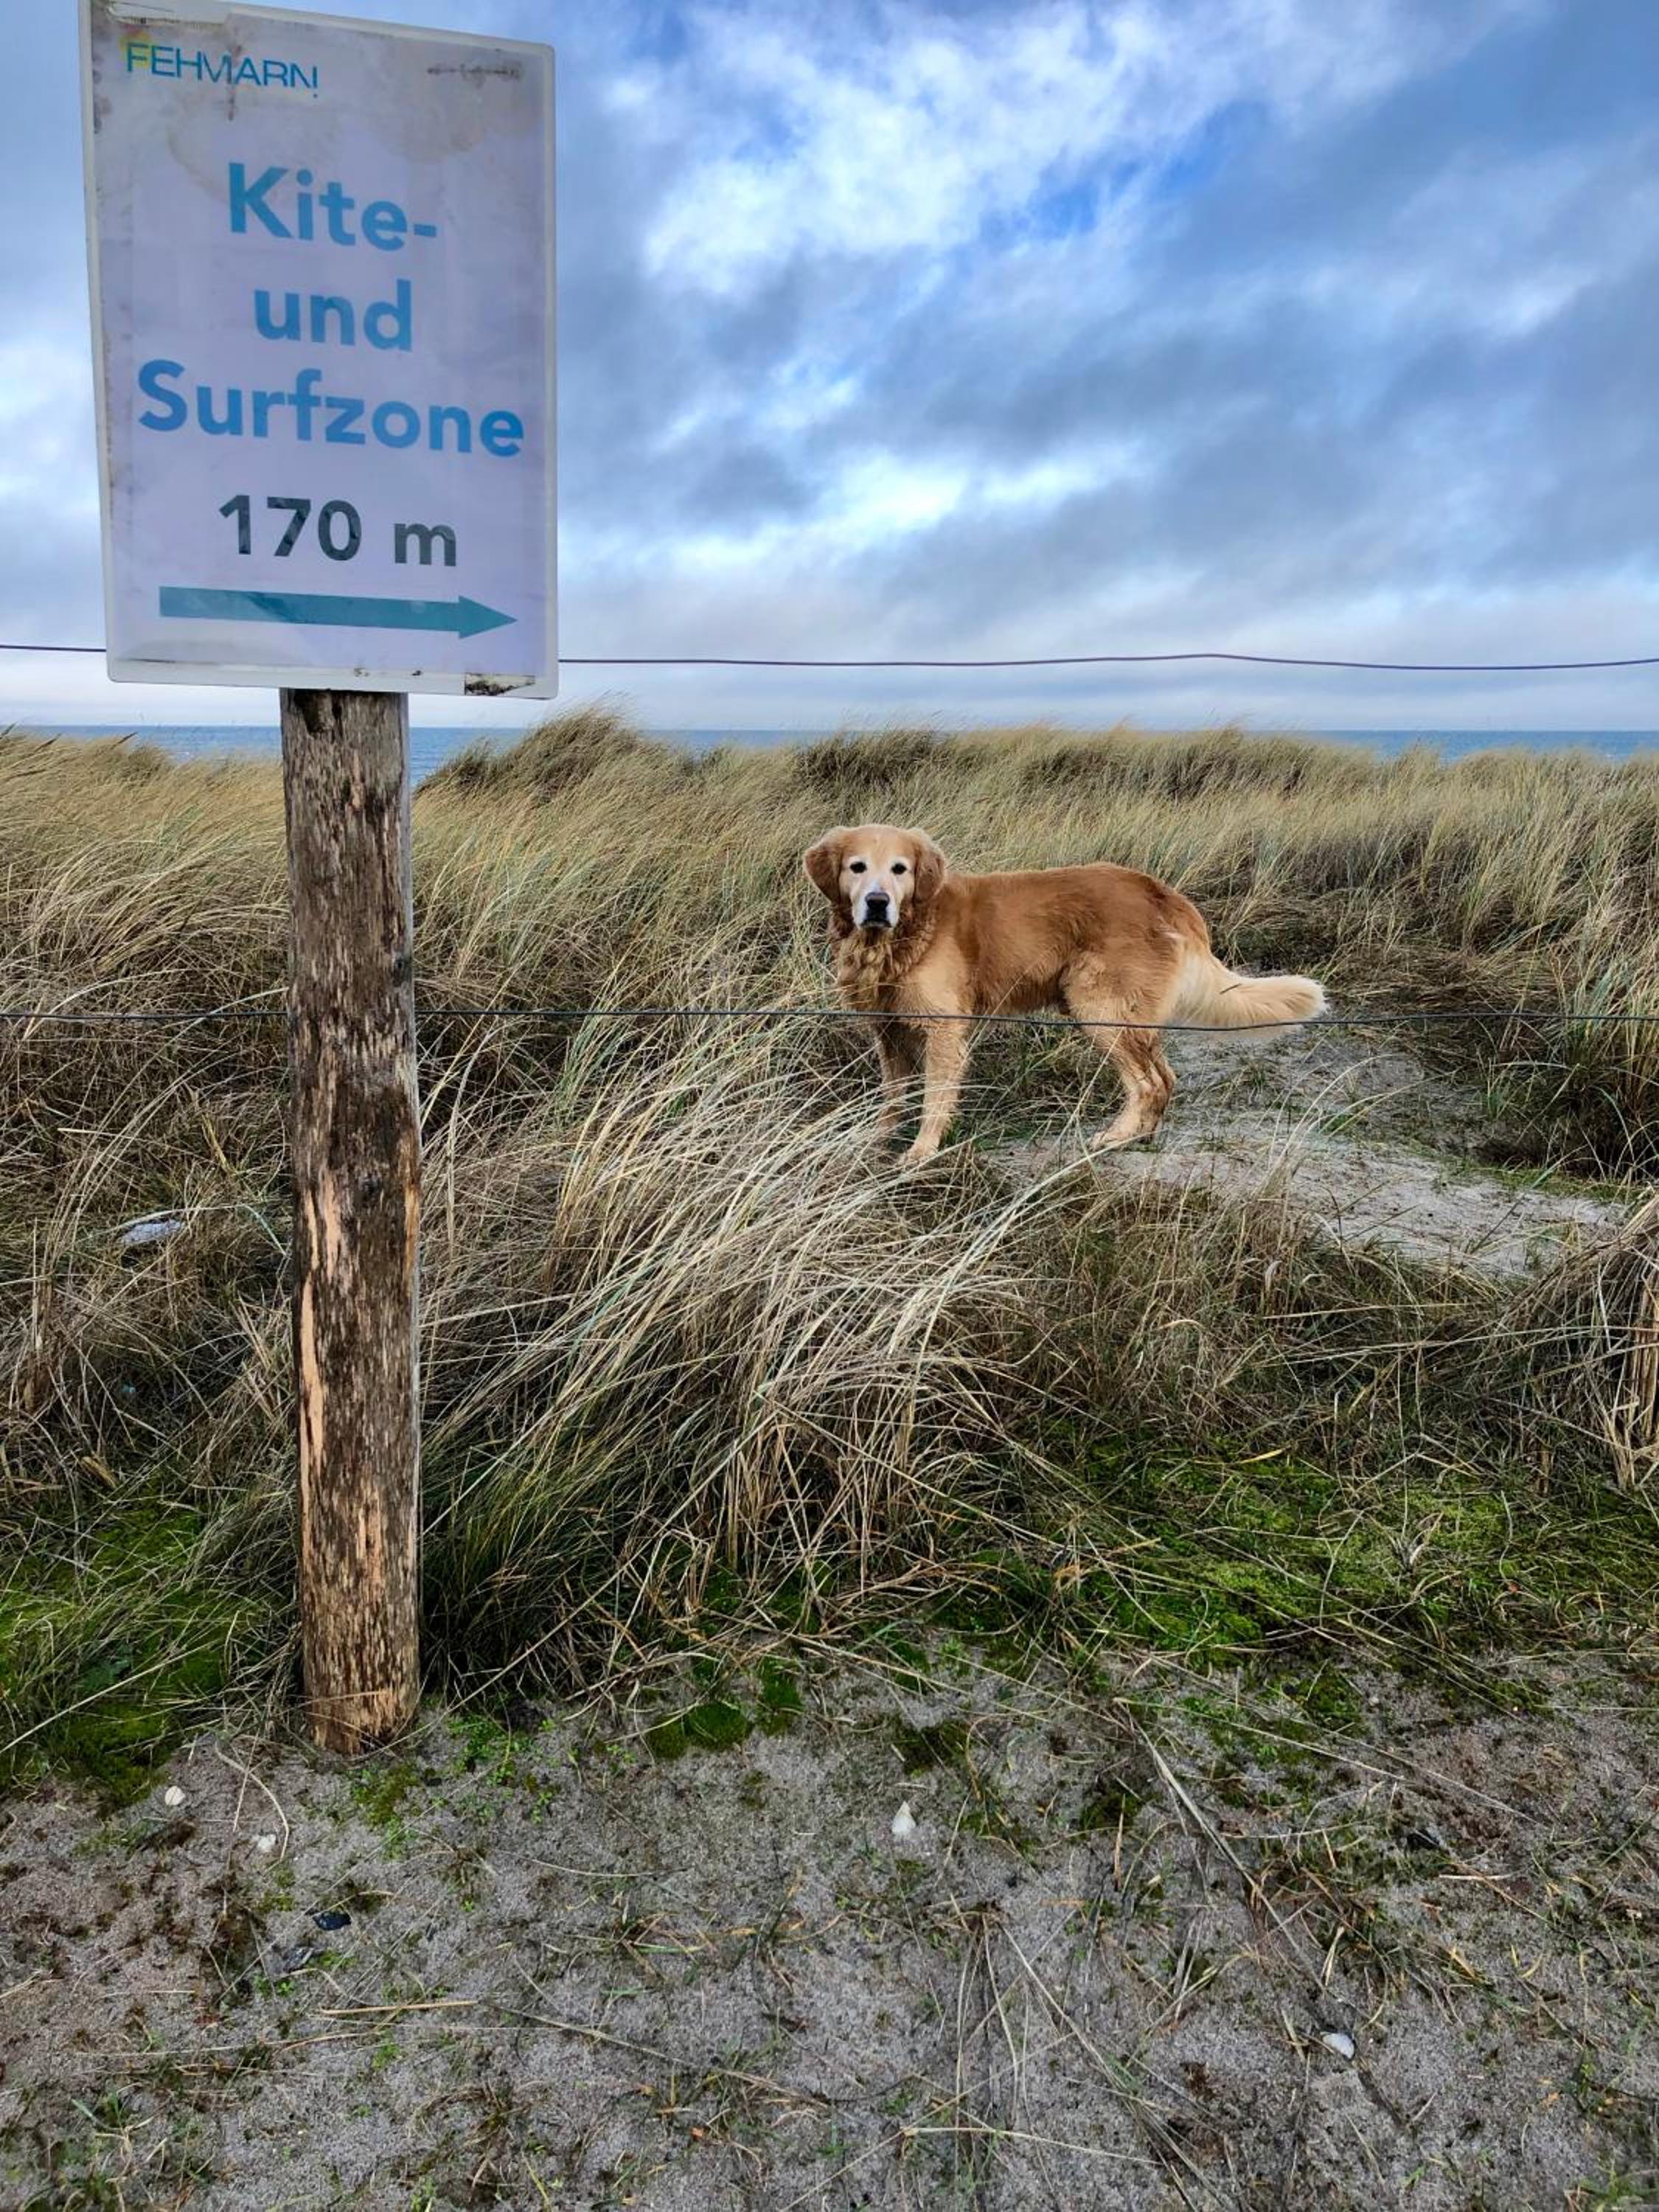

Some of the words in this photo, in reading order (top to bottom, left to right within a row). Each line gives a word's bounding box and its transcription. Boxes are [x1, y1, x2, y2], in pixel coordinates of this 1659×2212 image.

[126, 42, 319, 99] FEHMARN!
[228, 161, 437, 251] Kite-
[254, 278, 412, 352] und
[138, 360, 524, 456] Surfzone
[218, 494, 362, 561] 170
[393, 522, 456, 567] m
